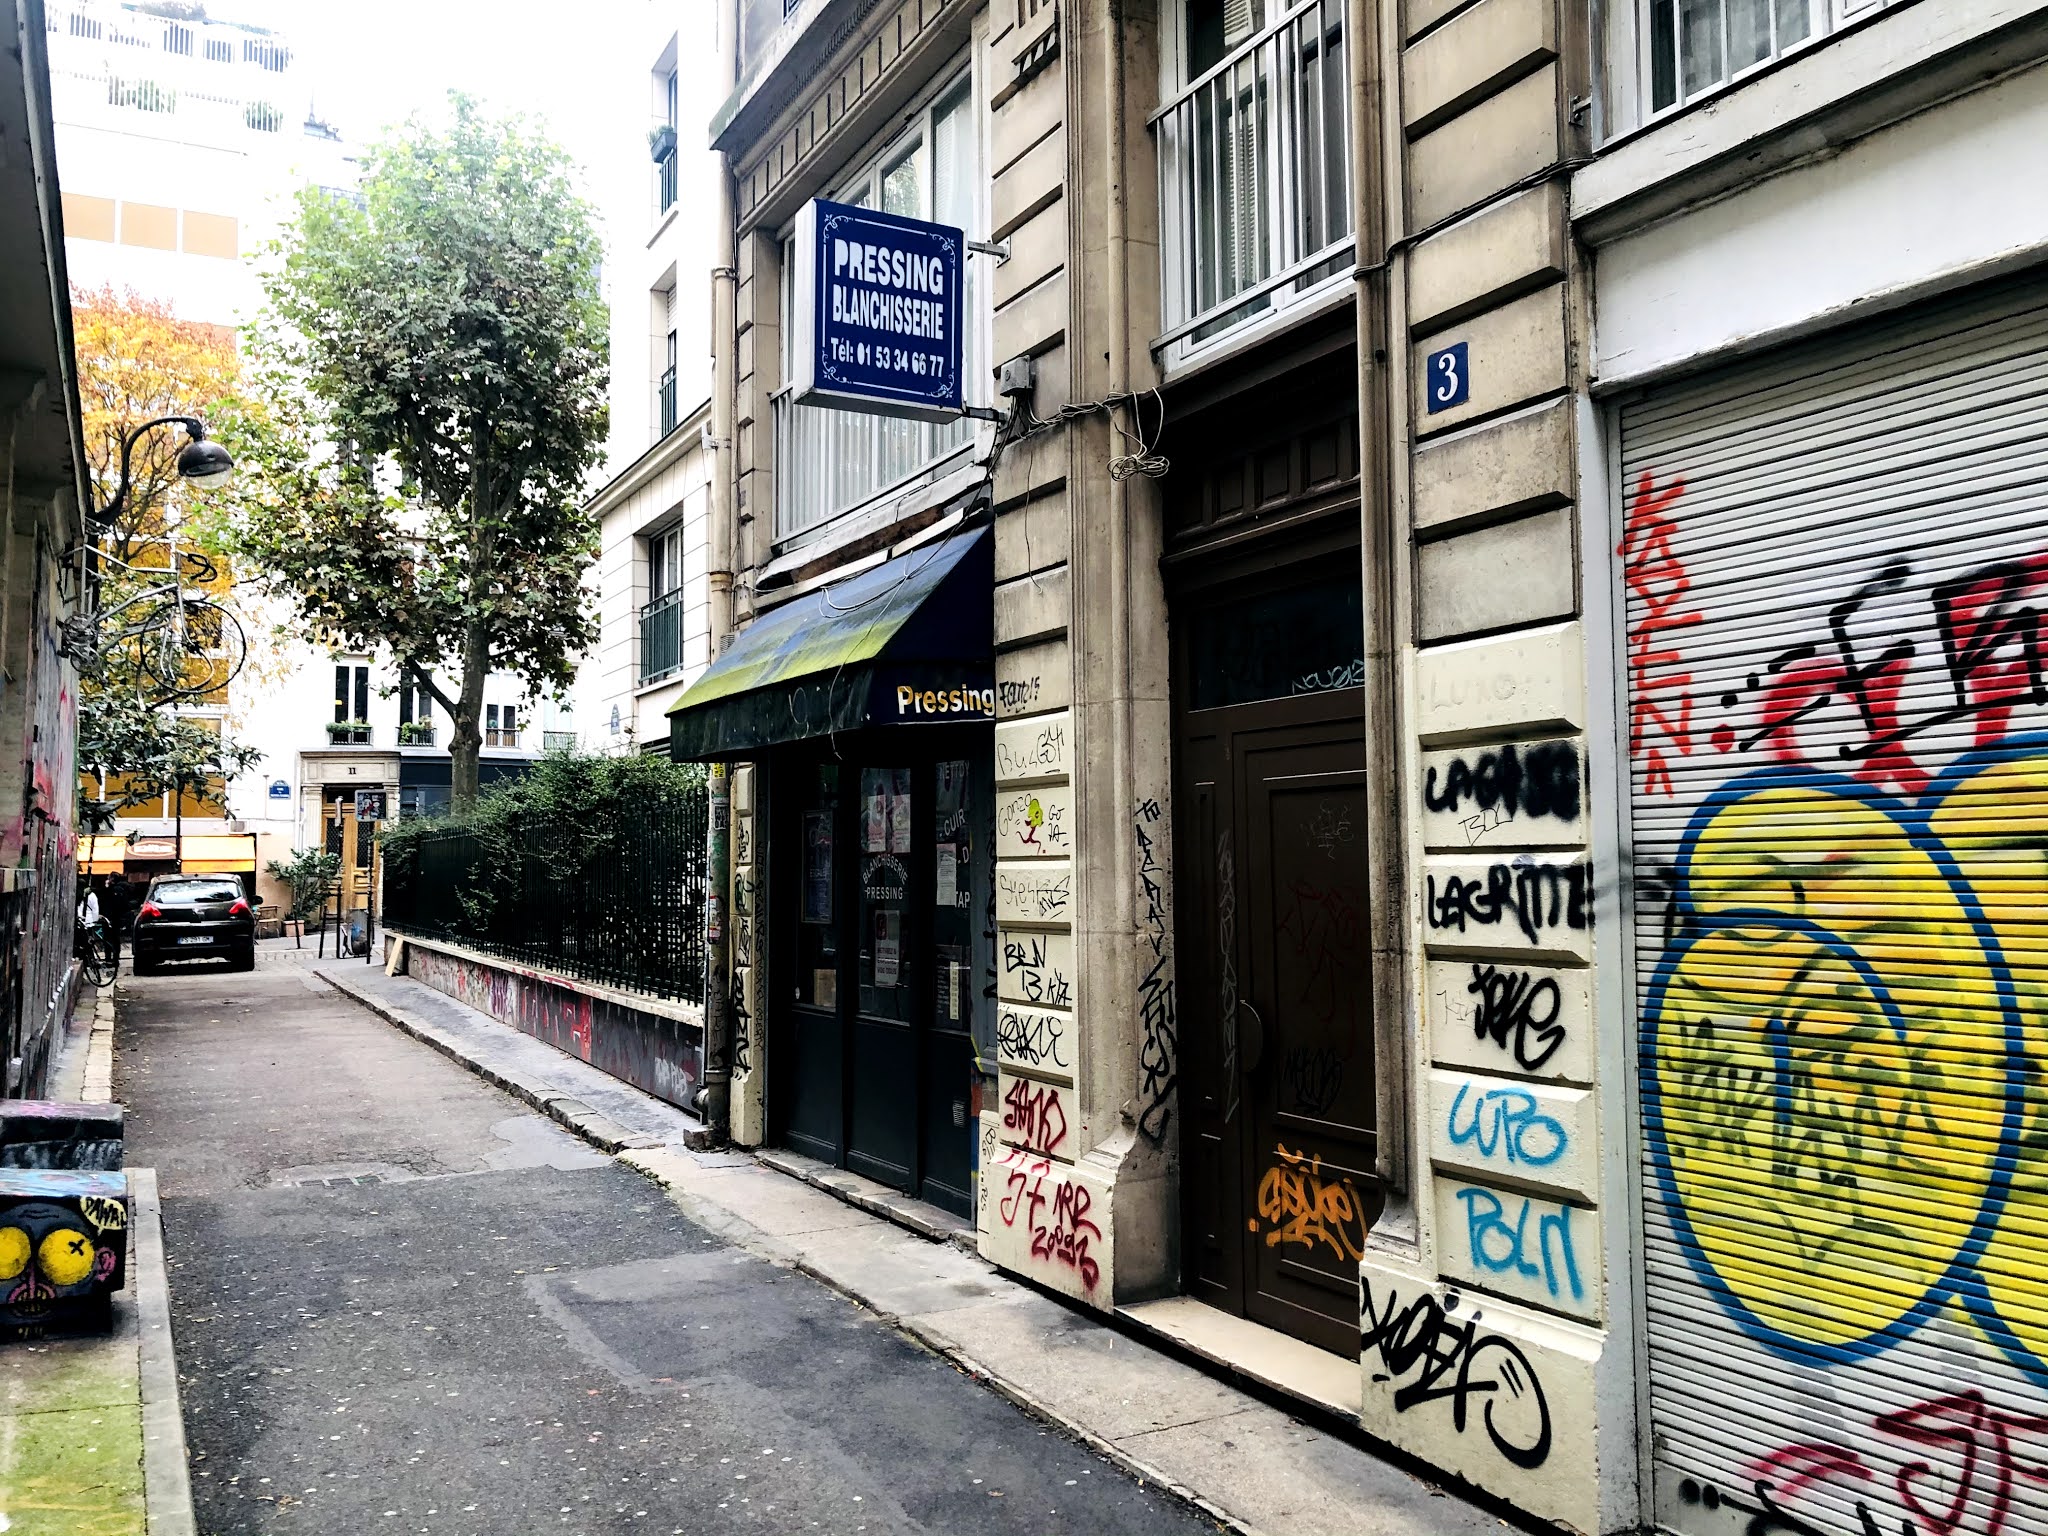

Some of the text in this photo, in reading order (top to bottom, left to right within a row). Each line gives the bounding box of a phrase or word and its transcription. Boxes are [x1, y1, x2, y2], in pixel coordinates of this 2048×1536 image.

[833, 238, 944, 296] PRESSING
[832, 284, 944, 340] BLANCHISSERIE
[831, 337, 944, 378] Tél: 01 53 34 66 77
[1437, 352, 1459, 402] 3
[897, 683, 995, 718] Pressing
[944, 808, 966, 837] CUIR
[866, 886, 904, 900] PRESSING
